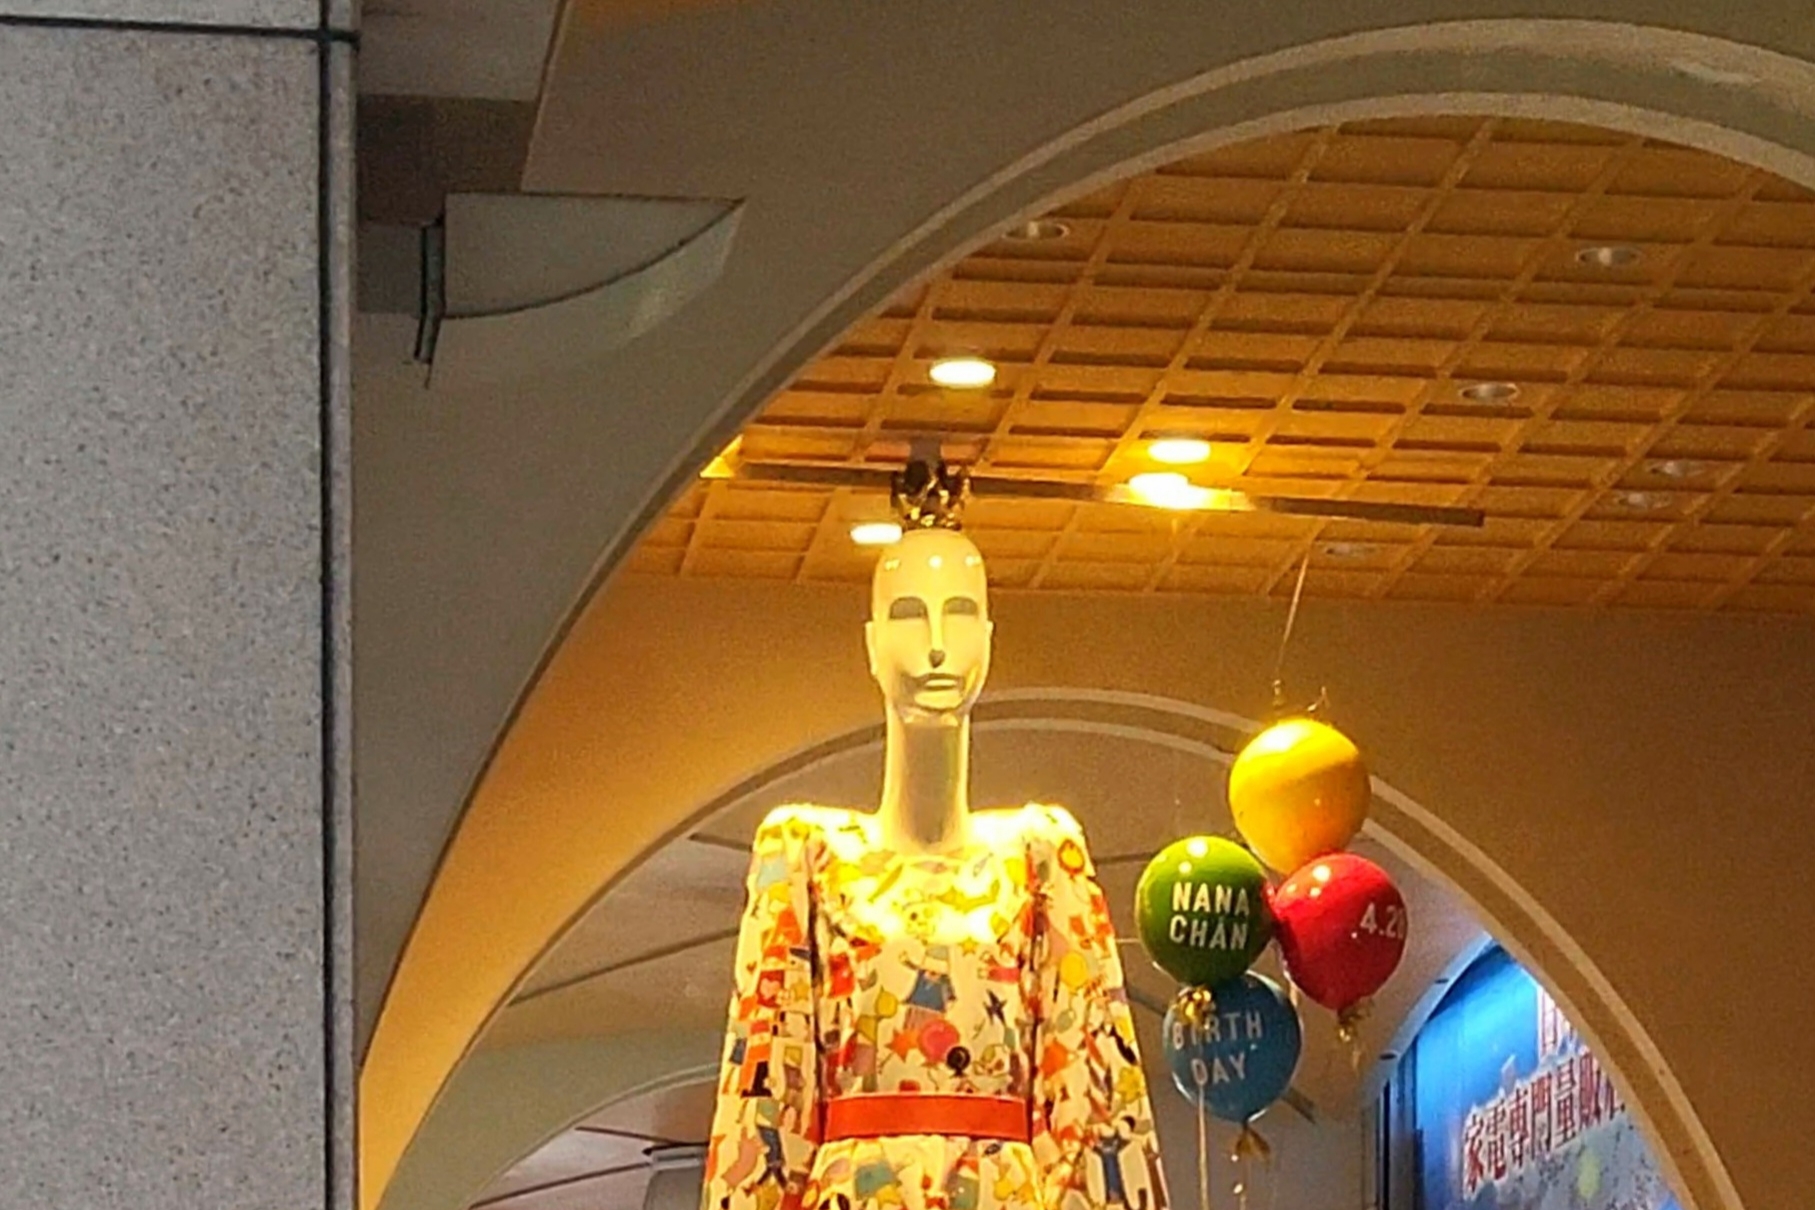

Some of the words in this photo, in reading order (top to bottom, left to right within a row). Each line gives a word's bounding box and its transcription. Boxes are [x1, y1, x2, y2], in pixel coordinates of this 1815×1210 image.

[1172, 882, 1250, 916] NANA
[1170, 915, 1248, 950] CHAN
[1191, 1052, 1245, 1086] DAY
